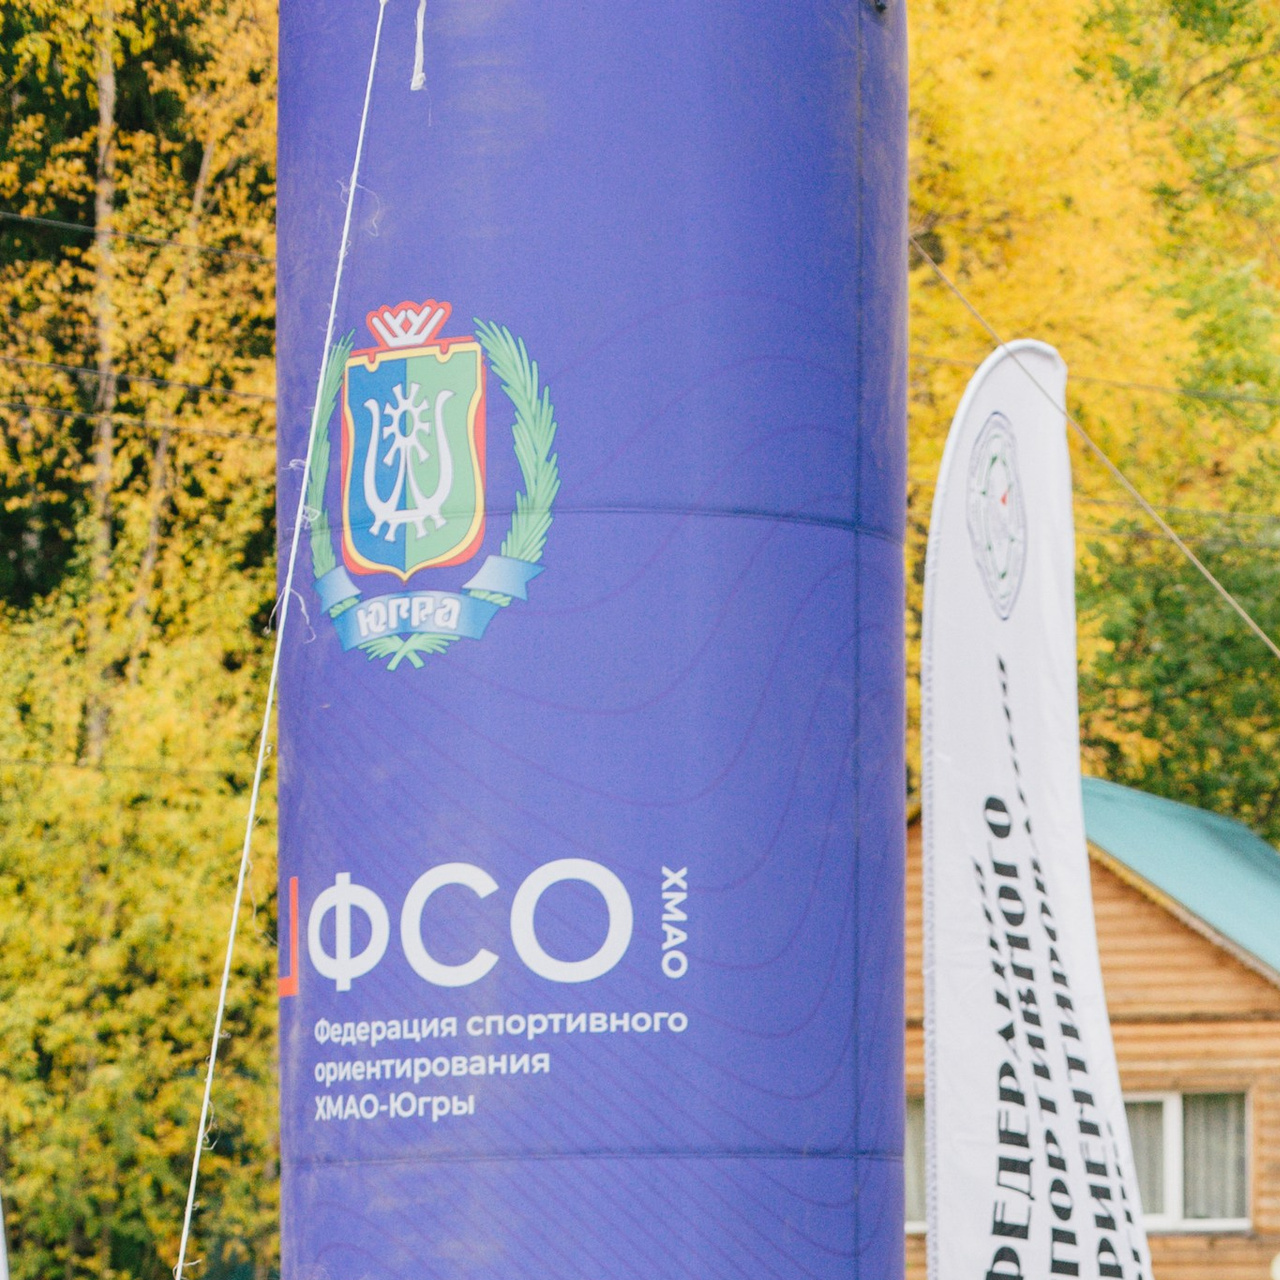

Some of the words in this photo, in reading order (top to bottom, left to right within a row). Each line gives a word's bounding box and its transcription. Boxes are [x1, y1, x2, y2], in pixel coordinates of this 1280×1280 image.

[307, 857, 634, 992] ФСО
[661, 865, 688, 979] ХМАО
[314, 1015, 457, 1047] Федерация
[466, 1011, 688, 1040] спортивного
[314, 1053, 550, 1087] ориентирования
[314, 1091, 475, 1122] ХМАО-Югры
